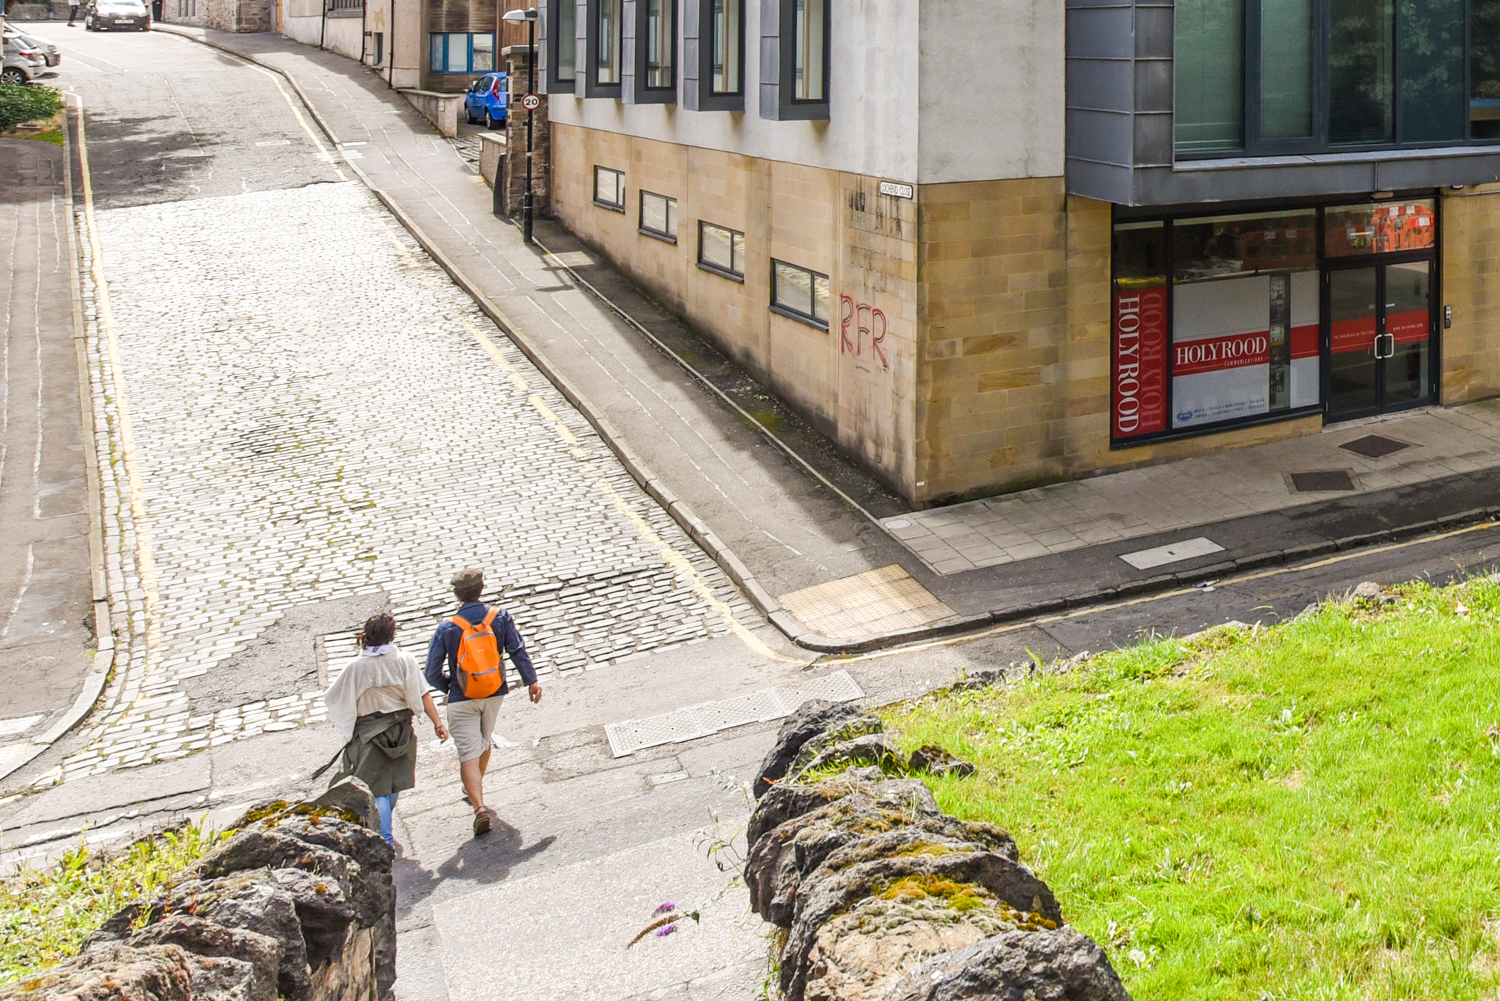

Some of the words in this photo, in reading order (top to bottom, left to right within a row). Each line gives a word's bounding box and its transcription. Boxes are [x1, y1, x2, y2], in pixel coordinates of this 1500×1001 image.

[1118, 295, 1140, 432] HOLYROOD
[1142, 293, 1162, 427] HOLYROOD
[1176, 336, 1267, 365] HOLYROOD
[1224, 356, 1264, 367] COMMUNICATIONS
